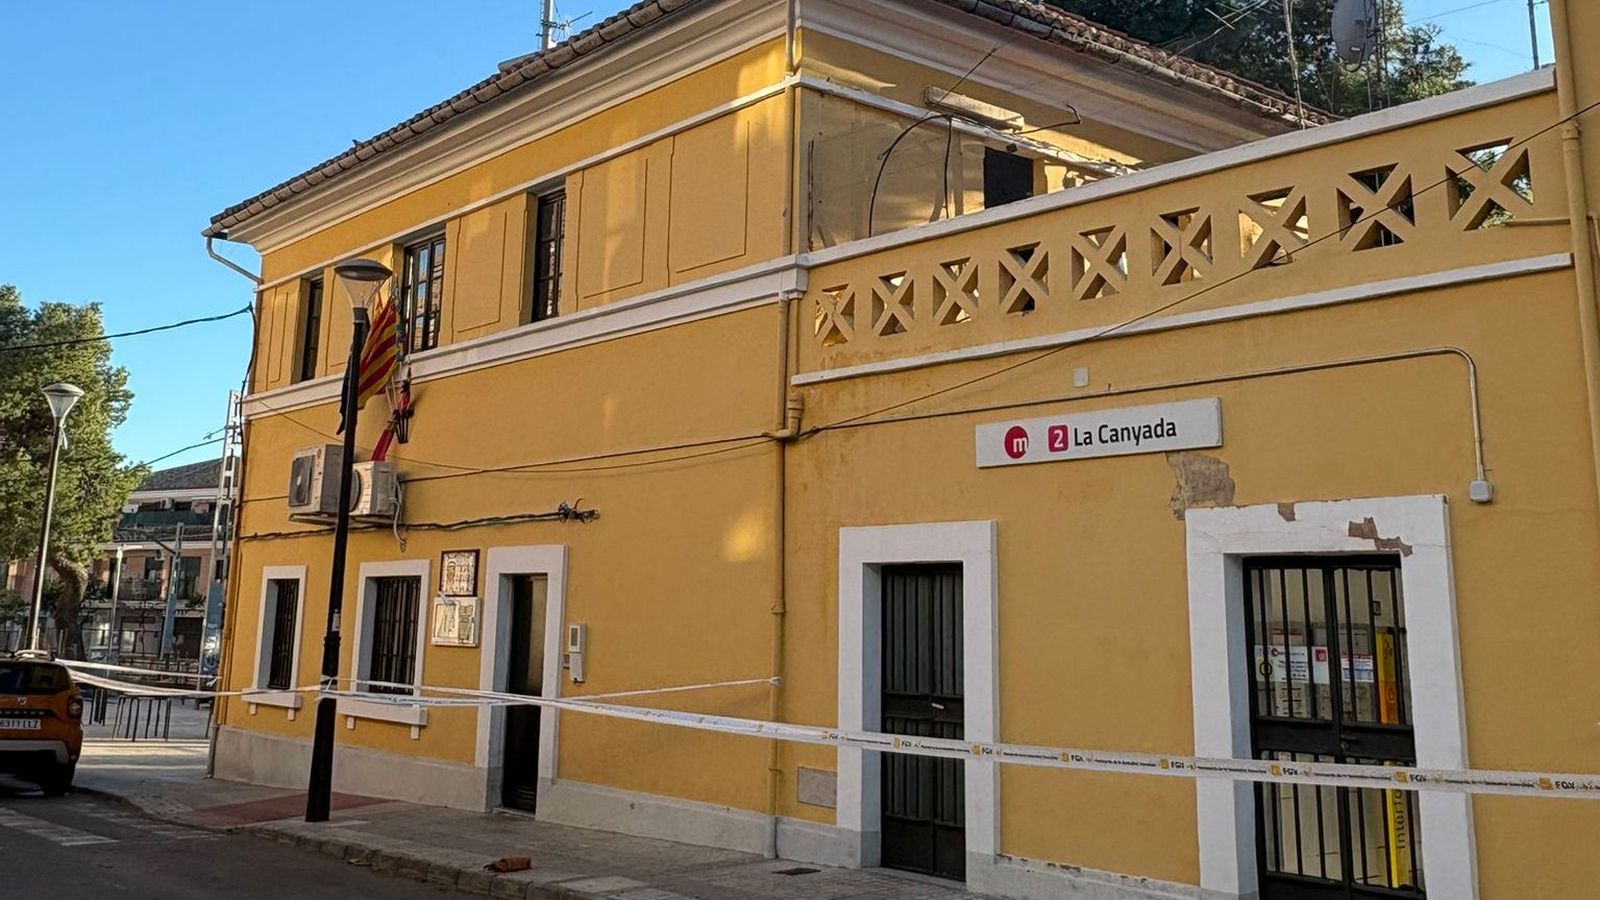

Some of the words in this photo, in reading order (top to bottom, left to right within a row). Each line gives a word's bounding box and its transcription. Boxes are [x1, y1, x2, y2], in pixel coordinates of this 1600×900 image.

[1053, 430, 1064, 449] 2
[1074, 427, 1093, 446] La
[1098, 417, 1177, 446] Canyada
